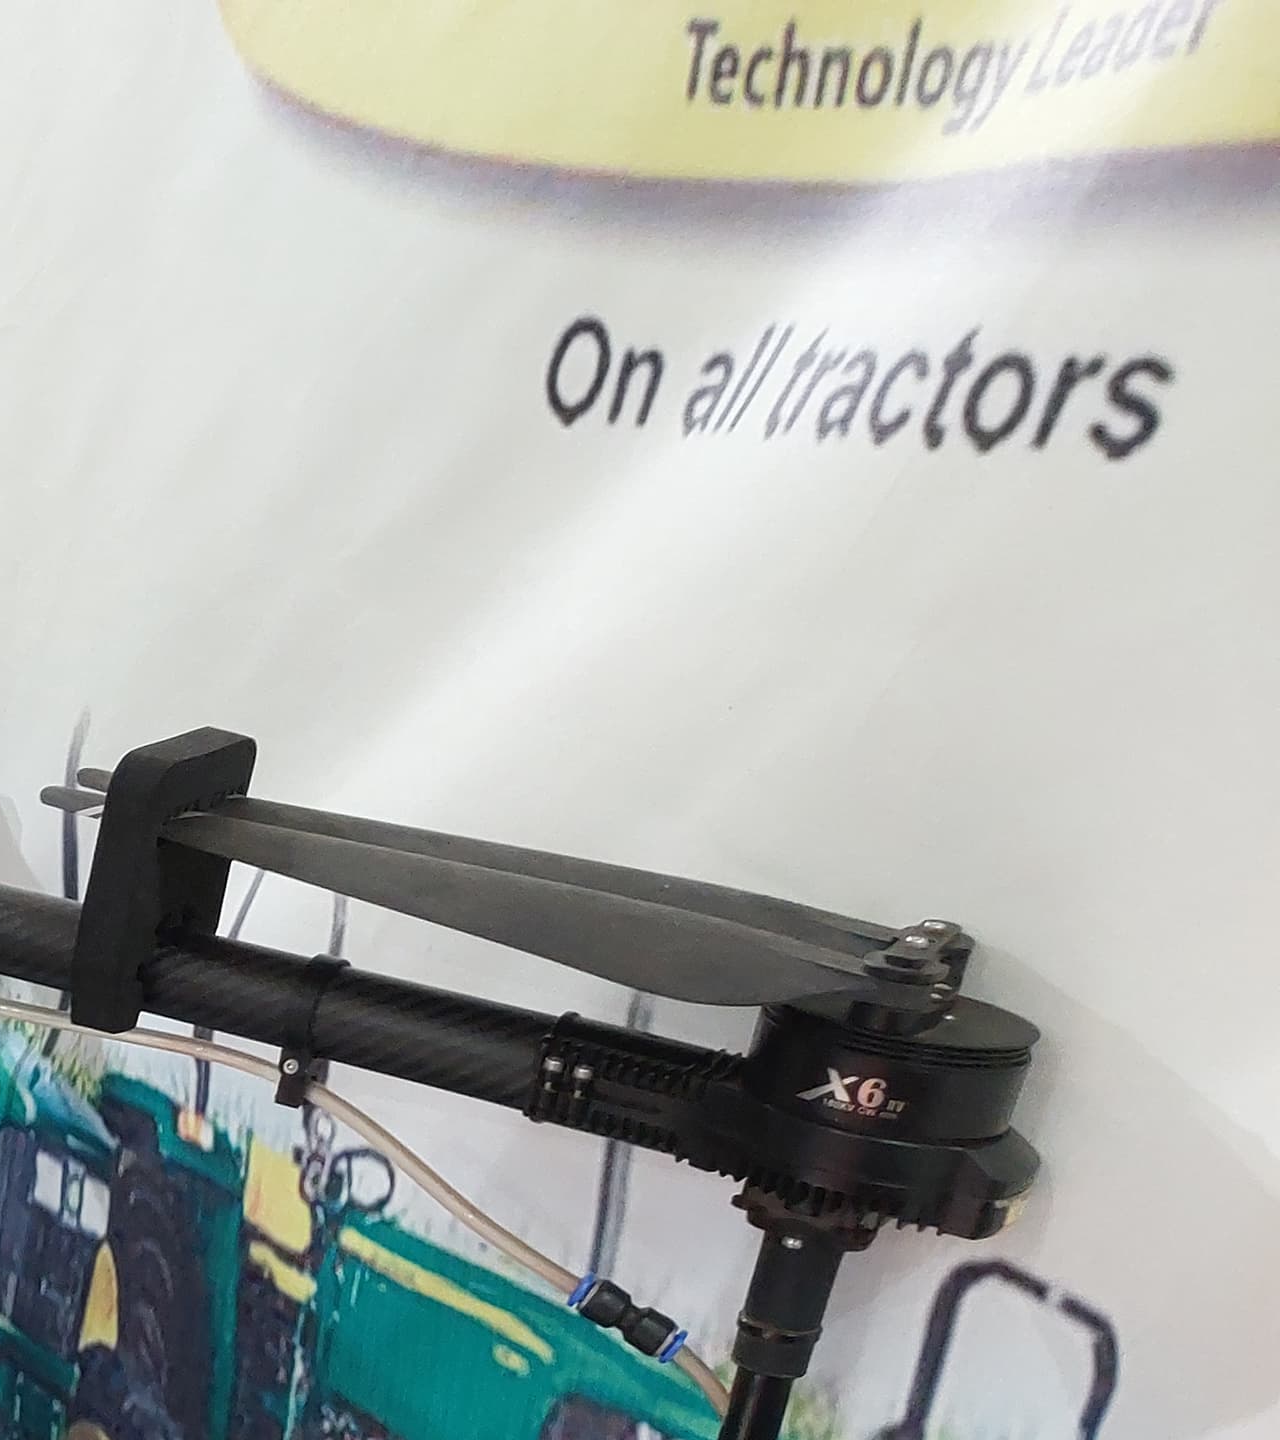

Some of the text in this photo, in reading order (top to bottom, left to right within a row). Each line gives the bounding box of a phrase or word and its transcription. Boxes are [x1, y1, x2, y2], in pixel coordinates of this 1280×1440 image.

[684, 14, 1029, 137] Technology
[546, 315, 1175, 461] On all tractors
